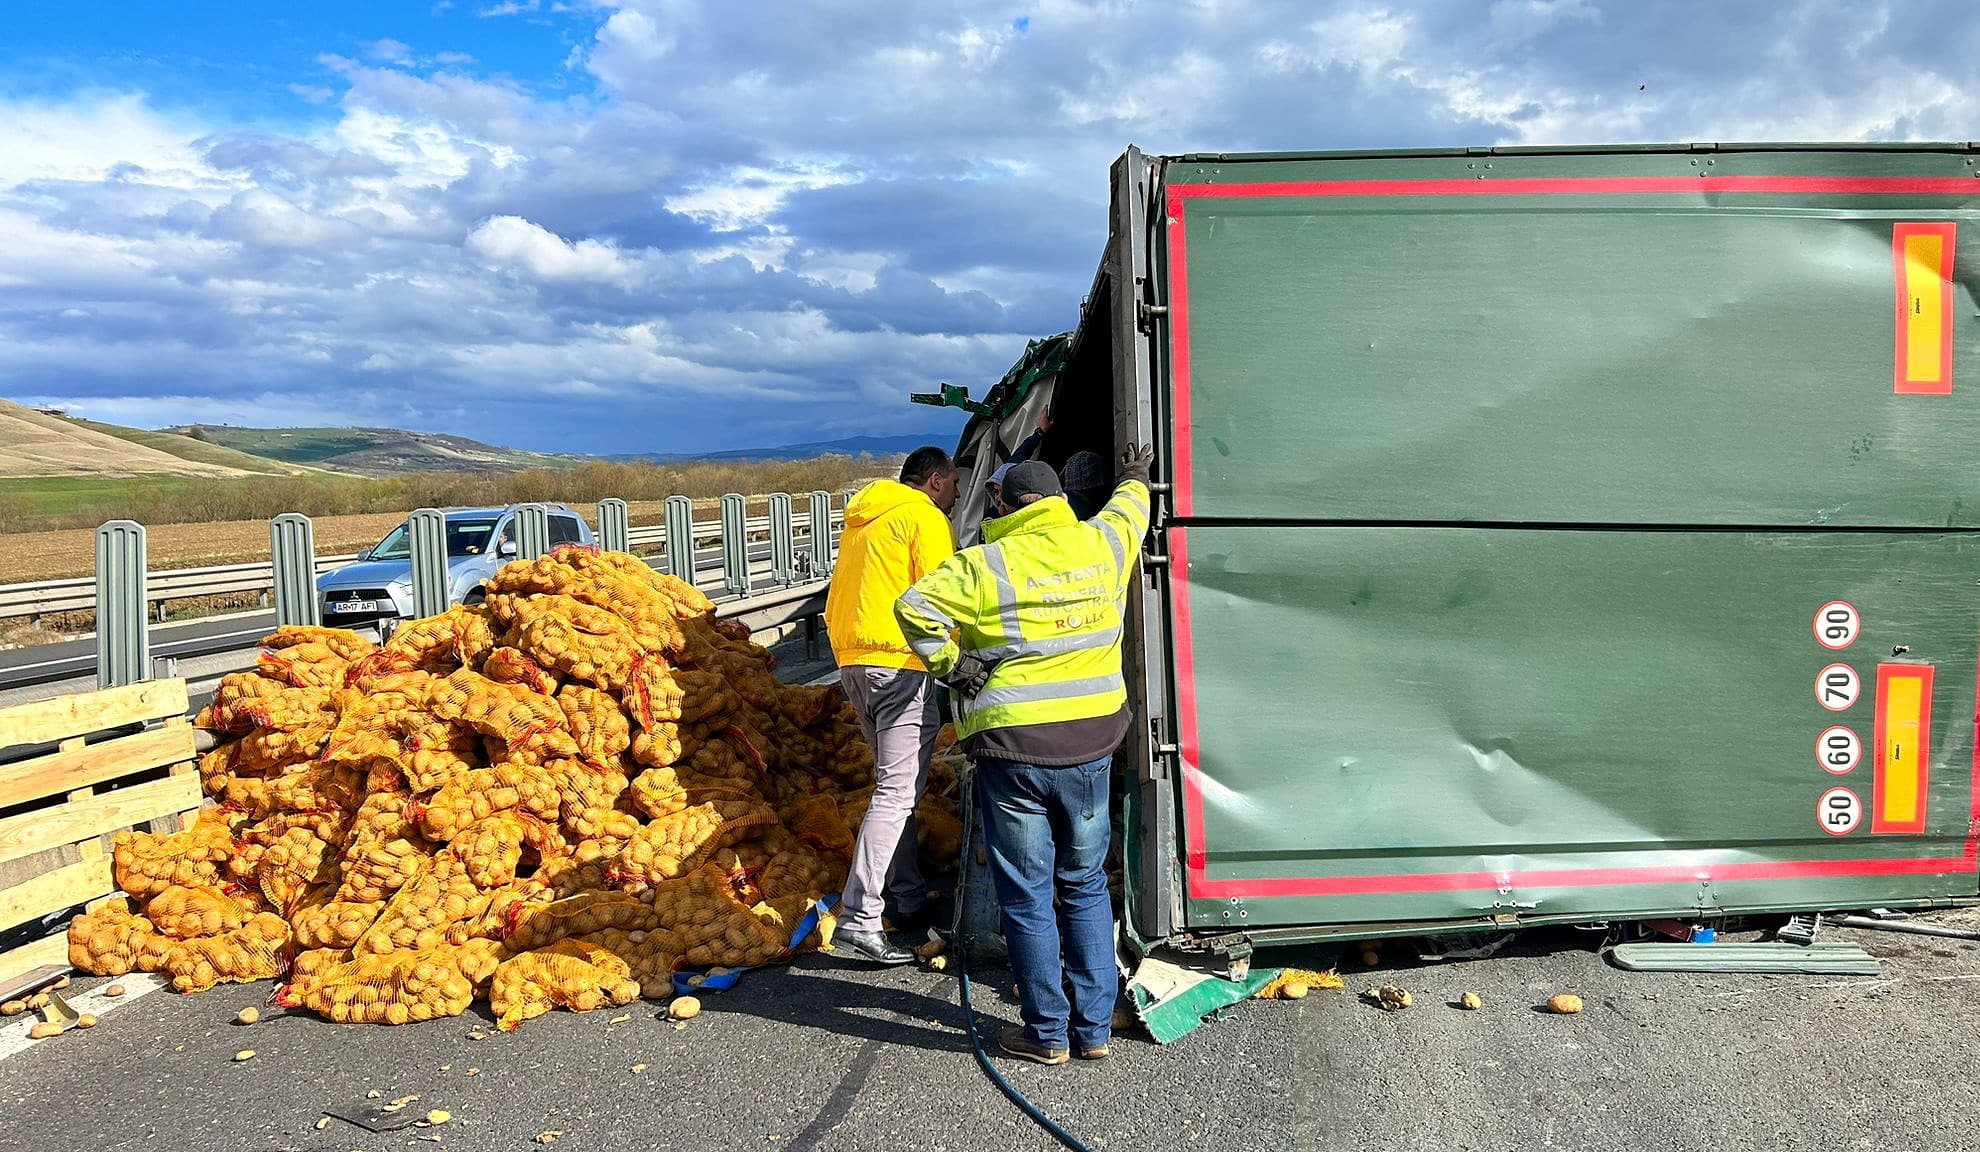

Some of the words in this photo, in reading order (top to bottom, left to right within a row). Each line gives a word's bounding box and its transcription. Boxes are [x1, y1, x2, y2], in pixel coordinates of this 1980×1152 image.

[1825, 609, 1850, 640] 90
[1825, 672, 1850, 701] 70
[1827, 735, 1851, 765] 60
[1828, 795, 1852, 825] 50
